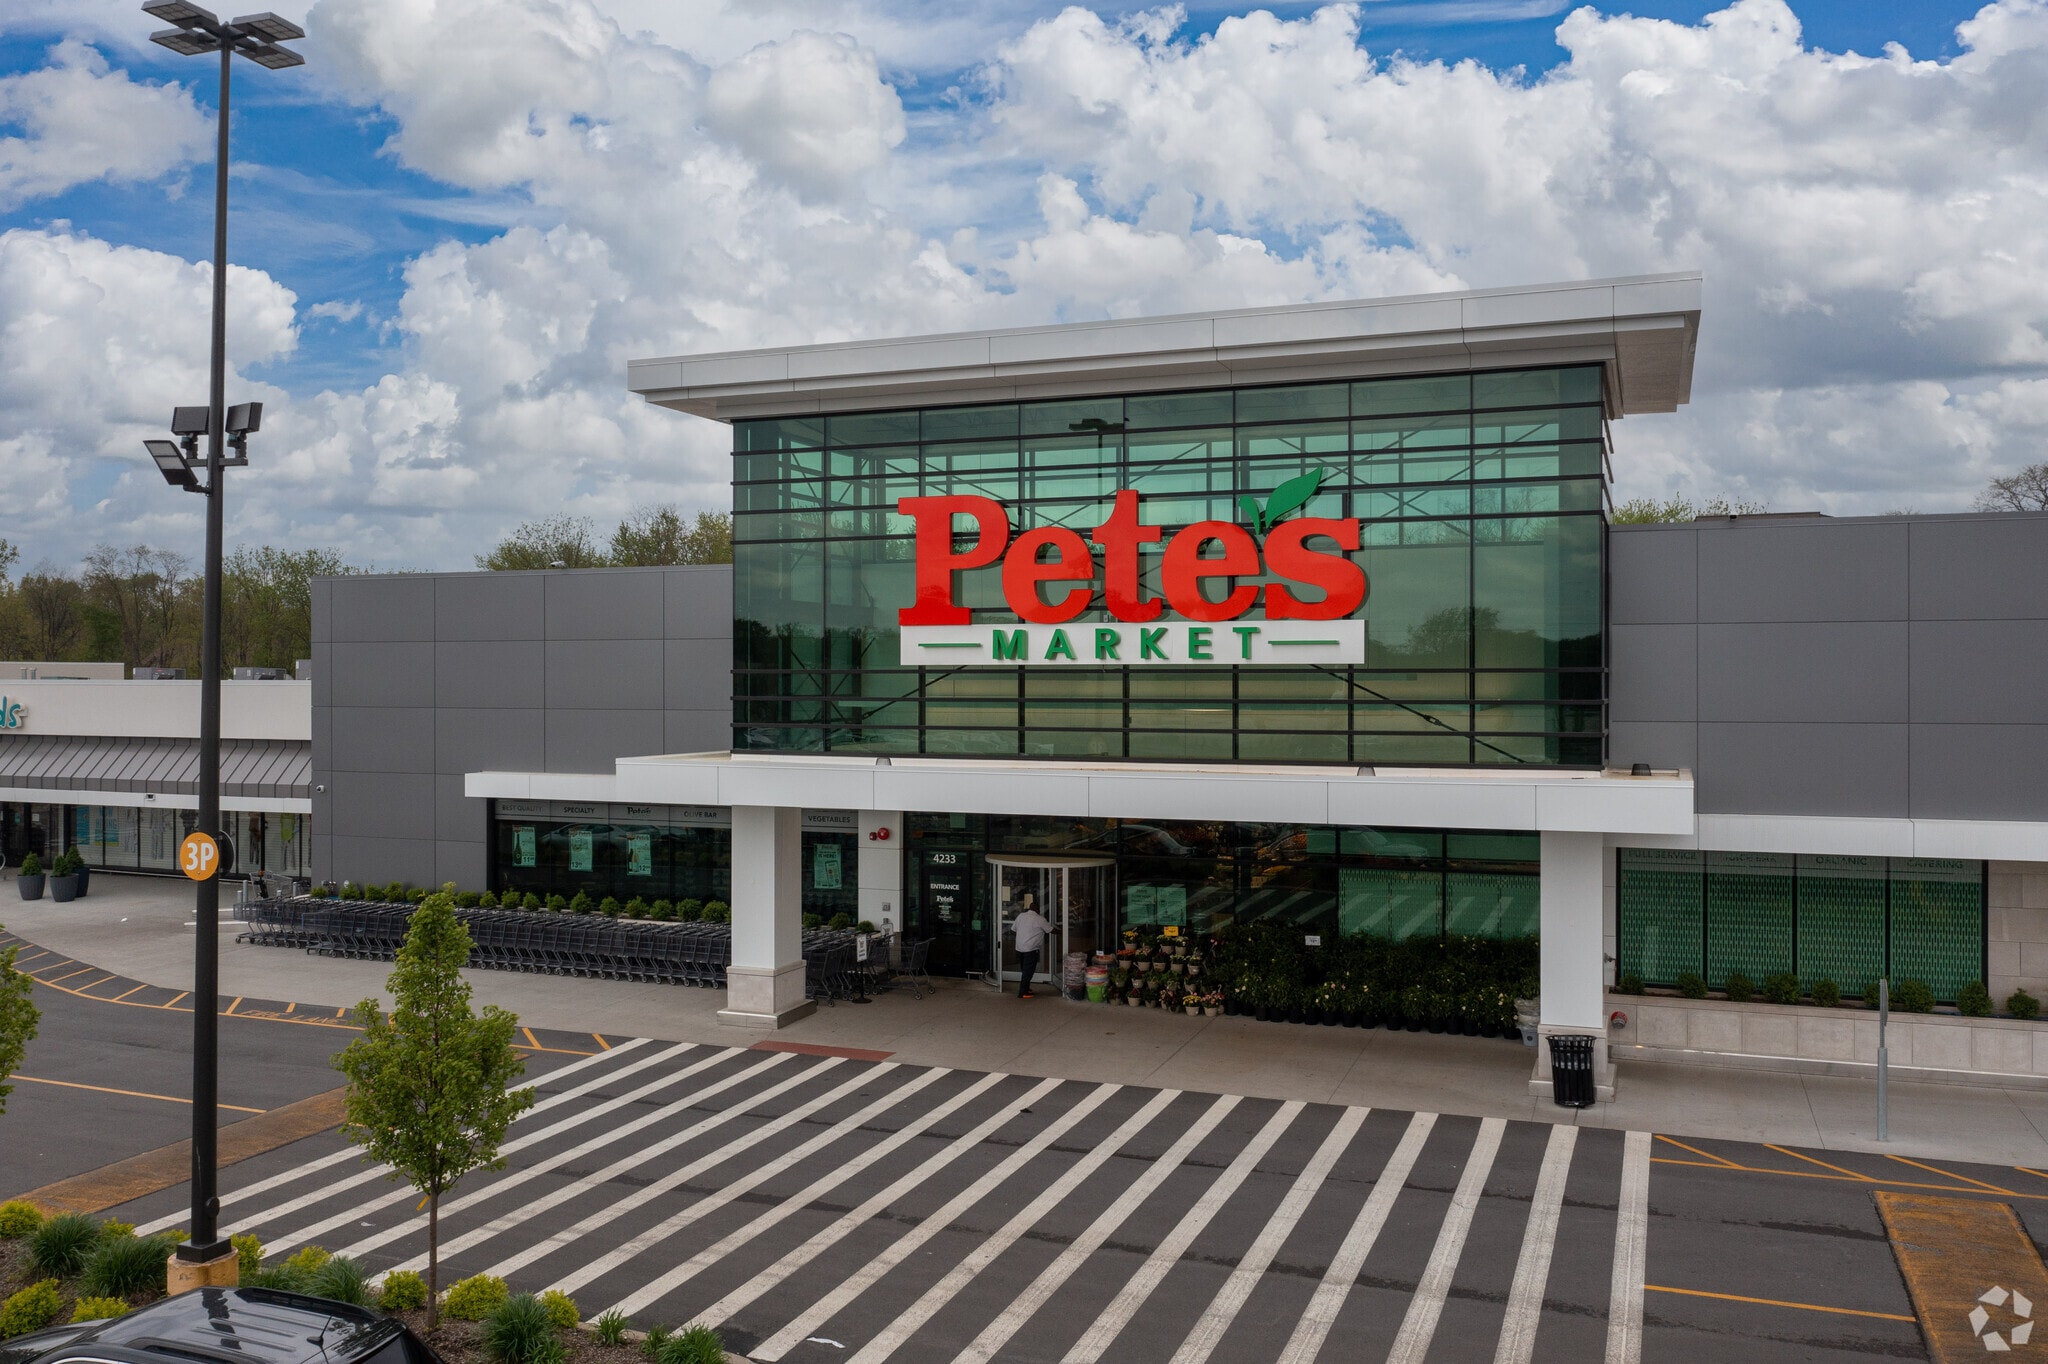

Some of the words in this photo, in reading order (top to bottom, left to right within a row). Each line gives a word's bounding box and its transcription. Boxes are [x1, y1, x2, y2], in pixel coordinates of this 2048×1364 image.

[991, 626, 1260, 661] MARKET
[563, 806, 595, 814] SPECIALTY
[807, 815, 852, 823] VEGETABLES
[186, 842, 214, 871] 3P
[933, 854, 956, 864] 4233
[1628, 849, 1653, 858] FULL
[1655, 851, 1697, 860] SERVICE
[1815, 857, 1868, 866] ORGANIC
[1907, 859, 1964, 869] CATERING
